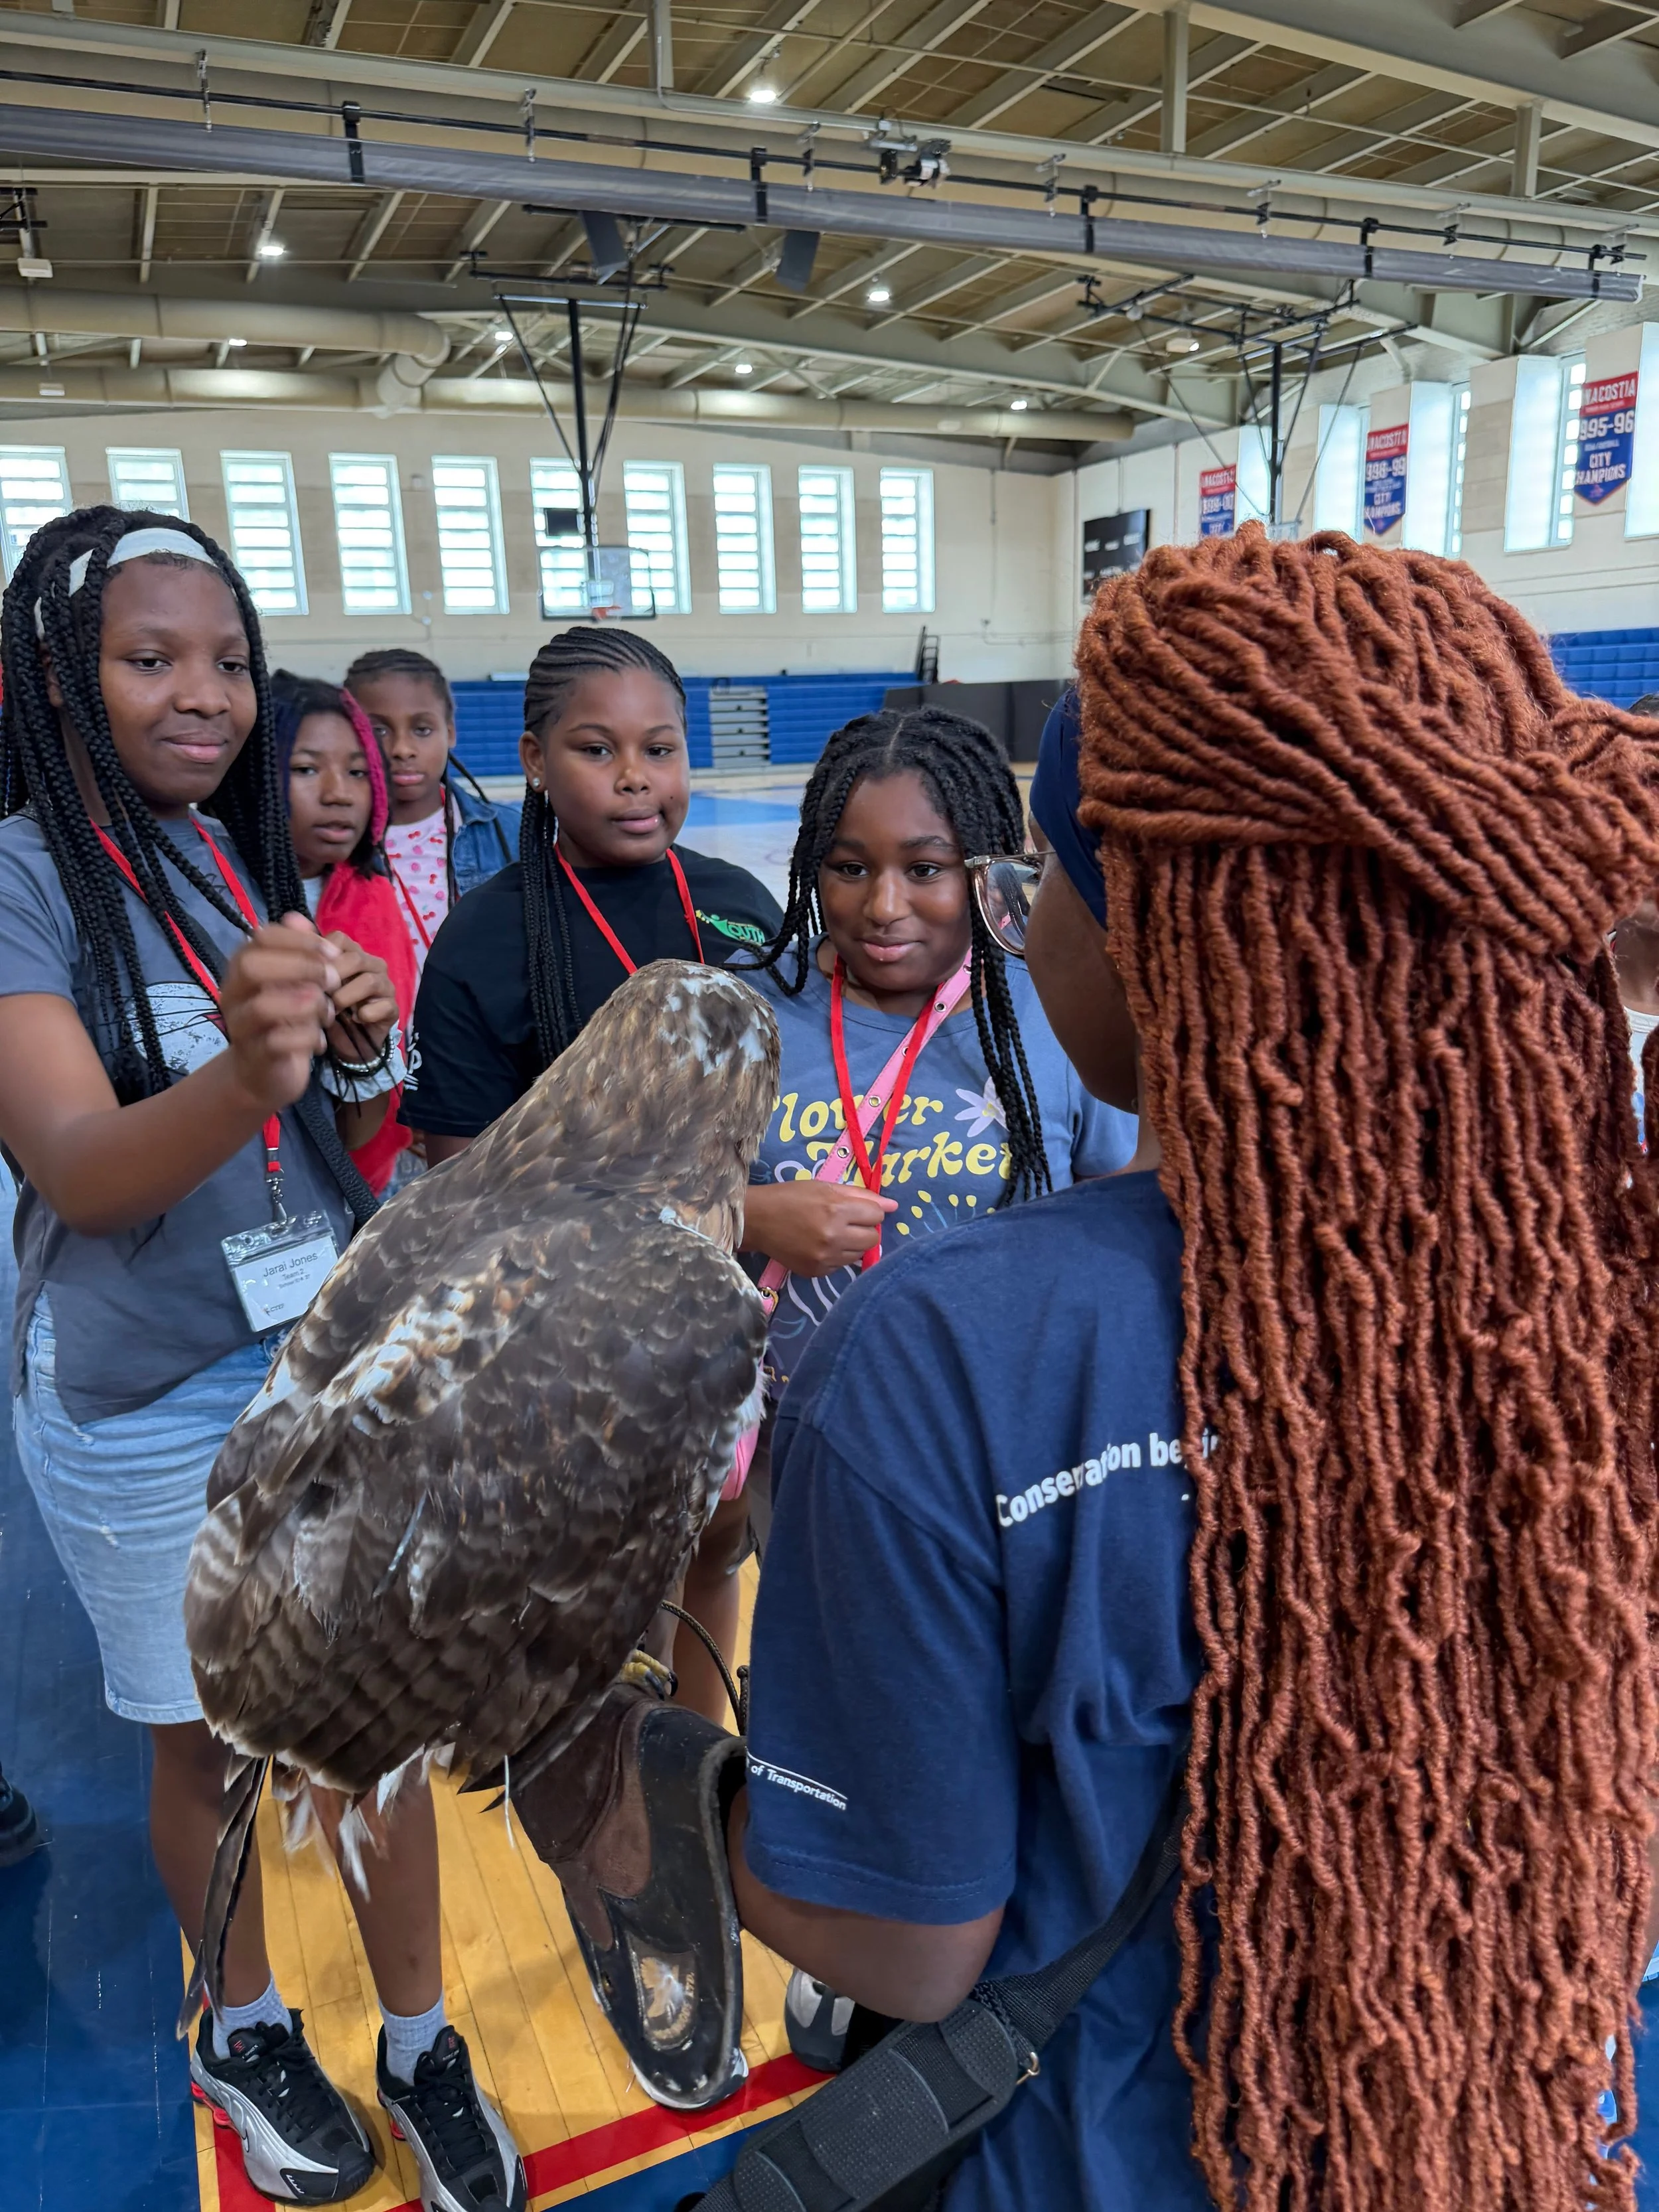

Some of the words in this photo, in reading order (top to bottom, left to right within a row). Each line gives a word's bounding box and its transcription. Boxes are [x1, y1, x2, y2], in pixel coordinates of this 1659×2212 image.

[1589, 451, 1612, 469] CITY
[263, 1262, 287, 1277] Jarai
[289, 1253, 318, 1268] Jones
[751, 1765, 765, 1776] of
[766, 1769, 847, 1811] Transportation
